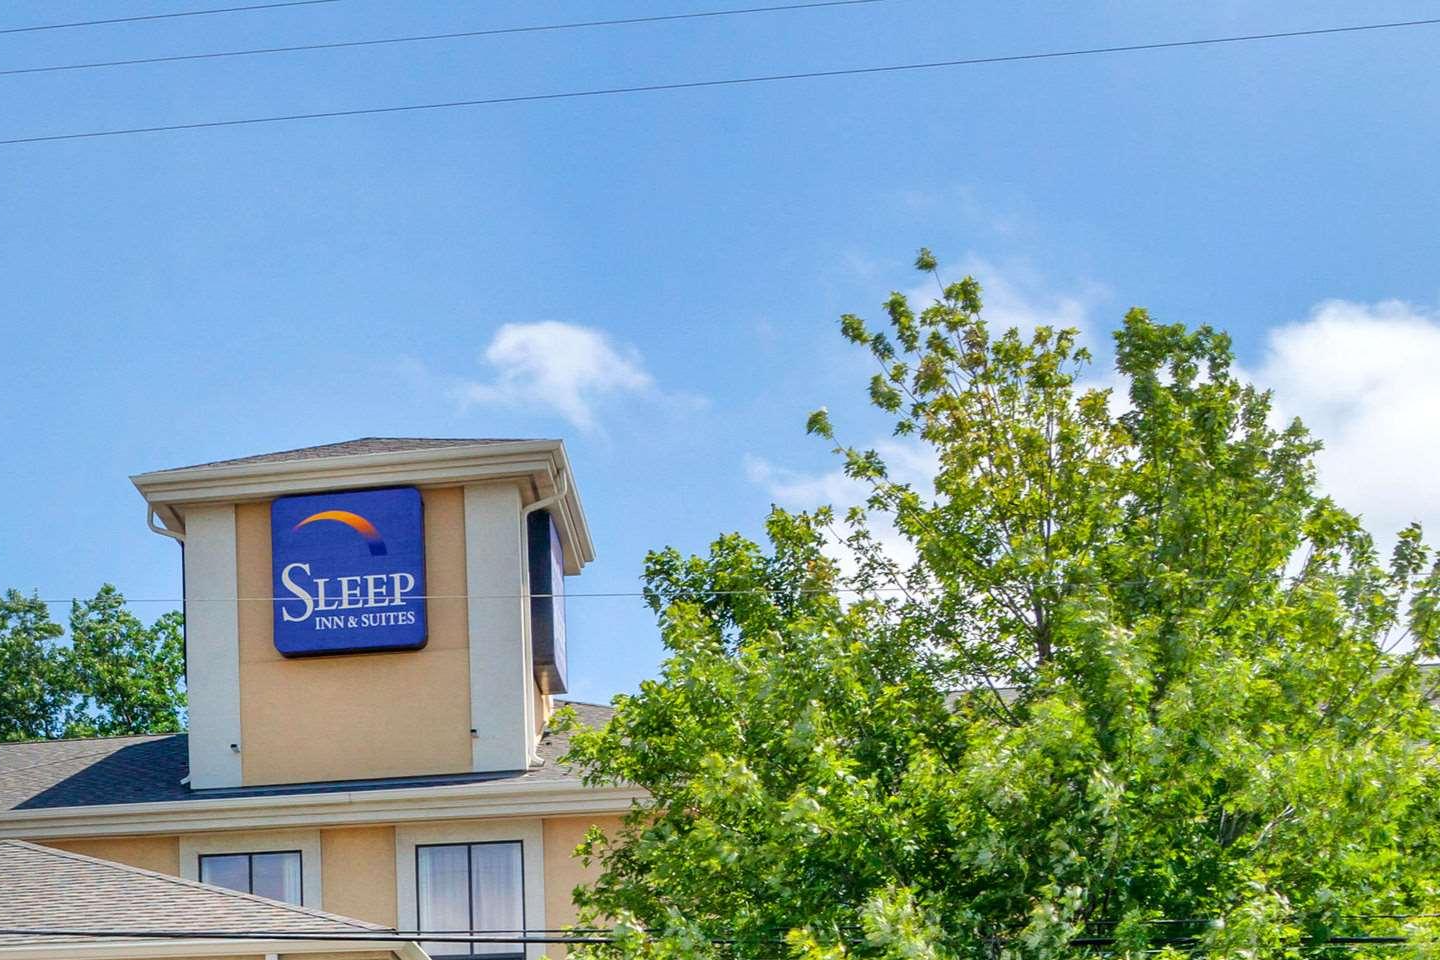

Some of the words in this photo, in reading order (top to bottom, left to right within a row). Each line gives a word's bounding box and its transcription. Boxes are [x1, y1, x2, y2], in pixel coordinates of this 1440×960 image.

[281, 562, 415, 622] SLEEP
[315, 615, 345, 630] INN
[347, 616, 359, 628] &
[361, 611, 416, 628] SUITES
